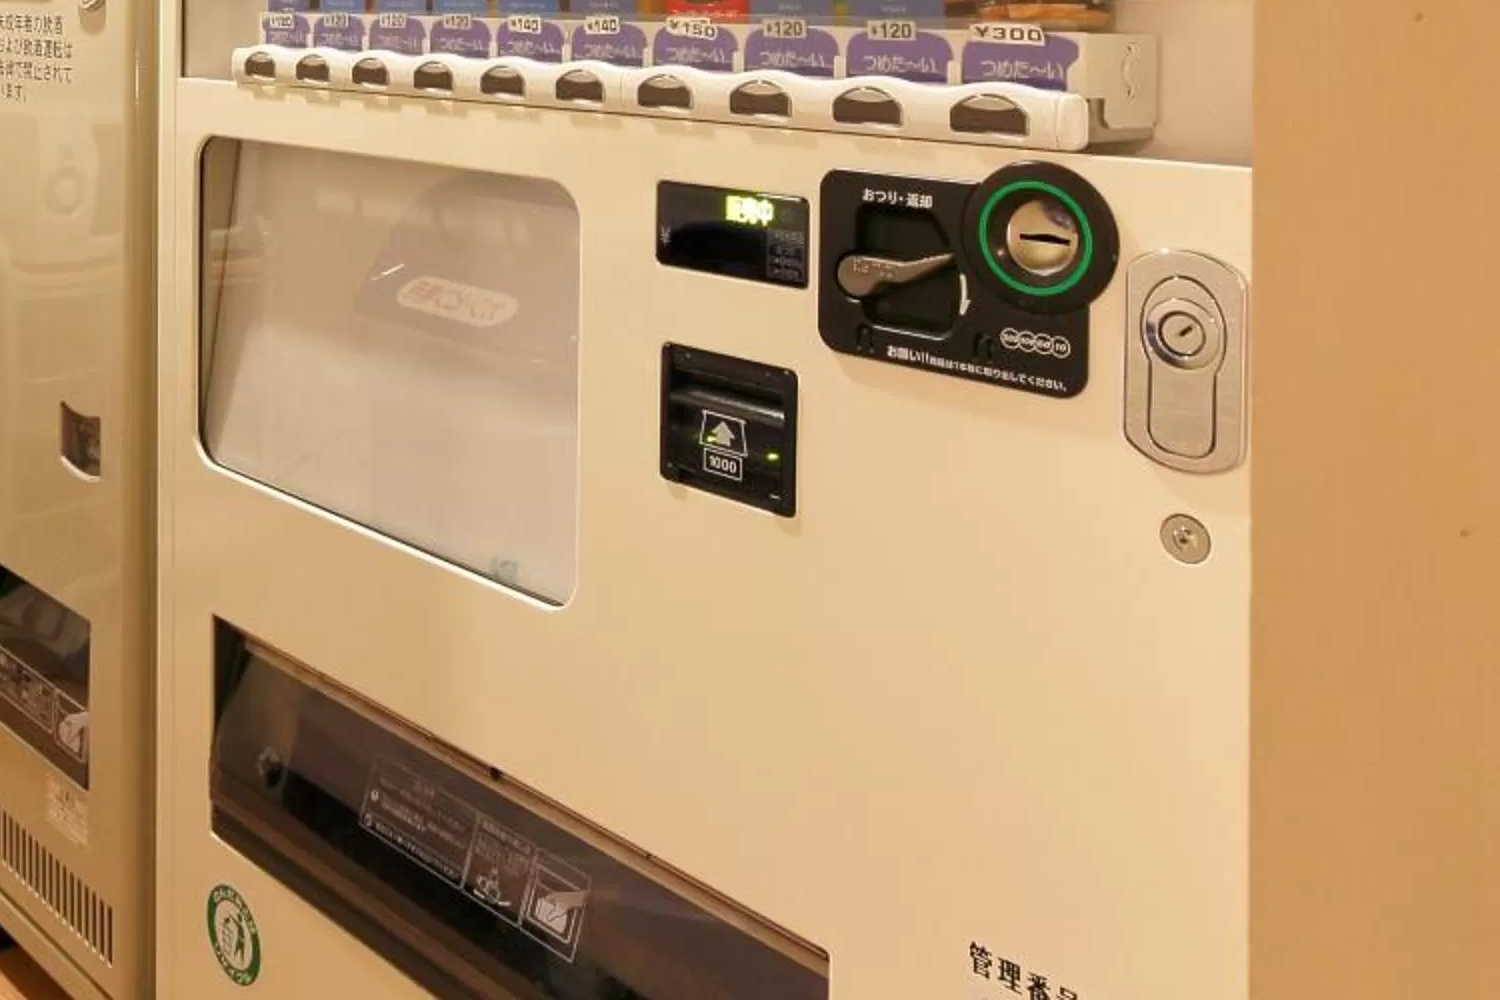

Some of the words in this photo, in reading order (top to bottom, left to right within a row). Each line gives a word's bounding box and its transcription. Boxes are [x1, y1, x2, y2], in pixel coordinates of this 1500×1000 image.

[587, 18, 617, 32] ¥140
[669, 18, 715, 38] ¥150
[765, 21, 804, 36] ¥120
[871, 22, 912, 38] ¥120
[975, 25, 1042, 42] ¥300
[708, 456, 737, 474] 1000
